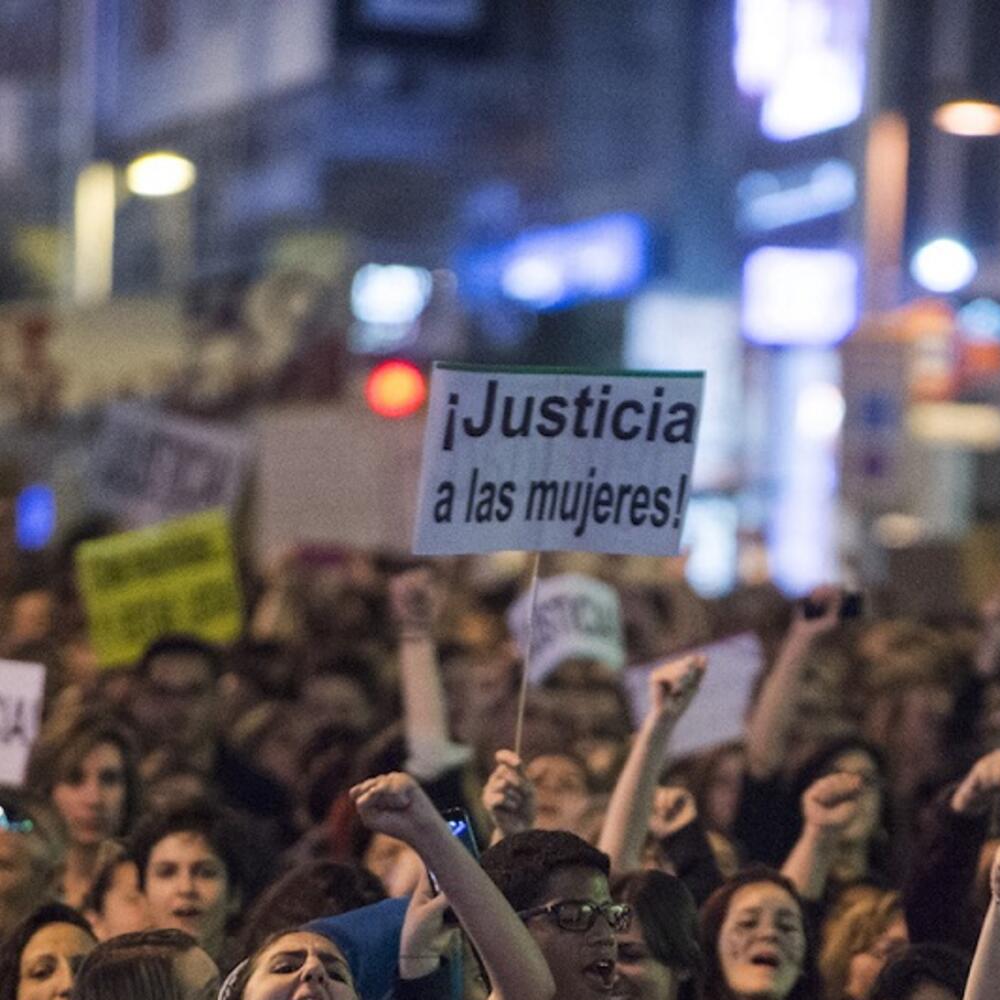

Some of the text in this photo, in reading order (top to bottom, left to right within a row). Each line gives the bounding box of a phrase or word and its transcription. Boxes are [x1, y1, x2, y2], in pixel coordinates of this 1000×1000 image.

[443, 379, 698, 451] ¡Justicia
[433, 466, 688, 538] a las mujeres!
